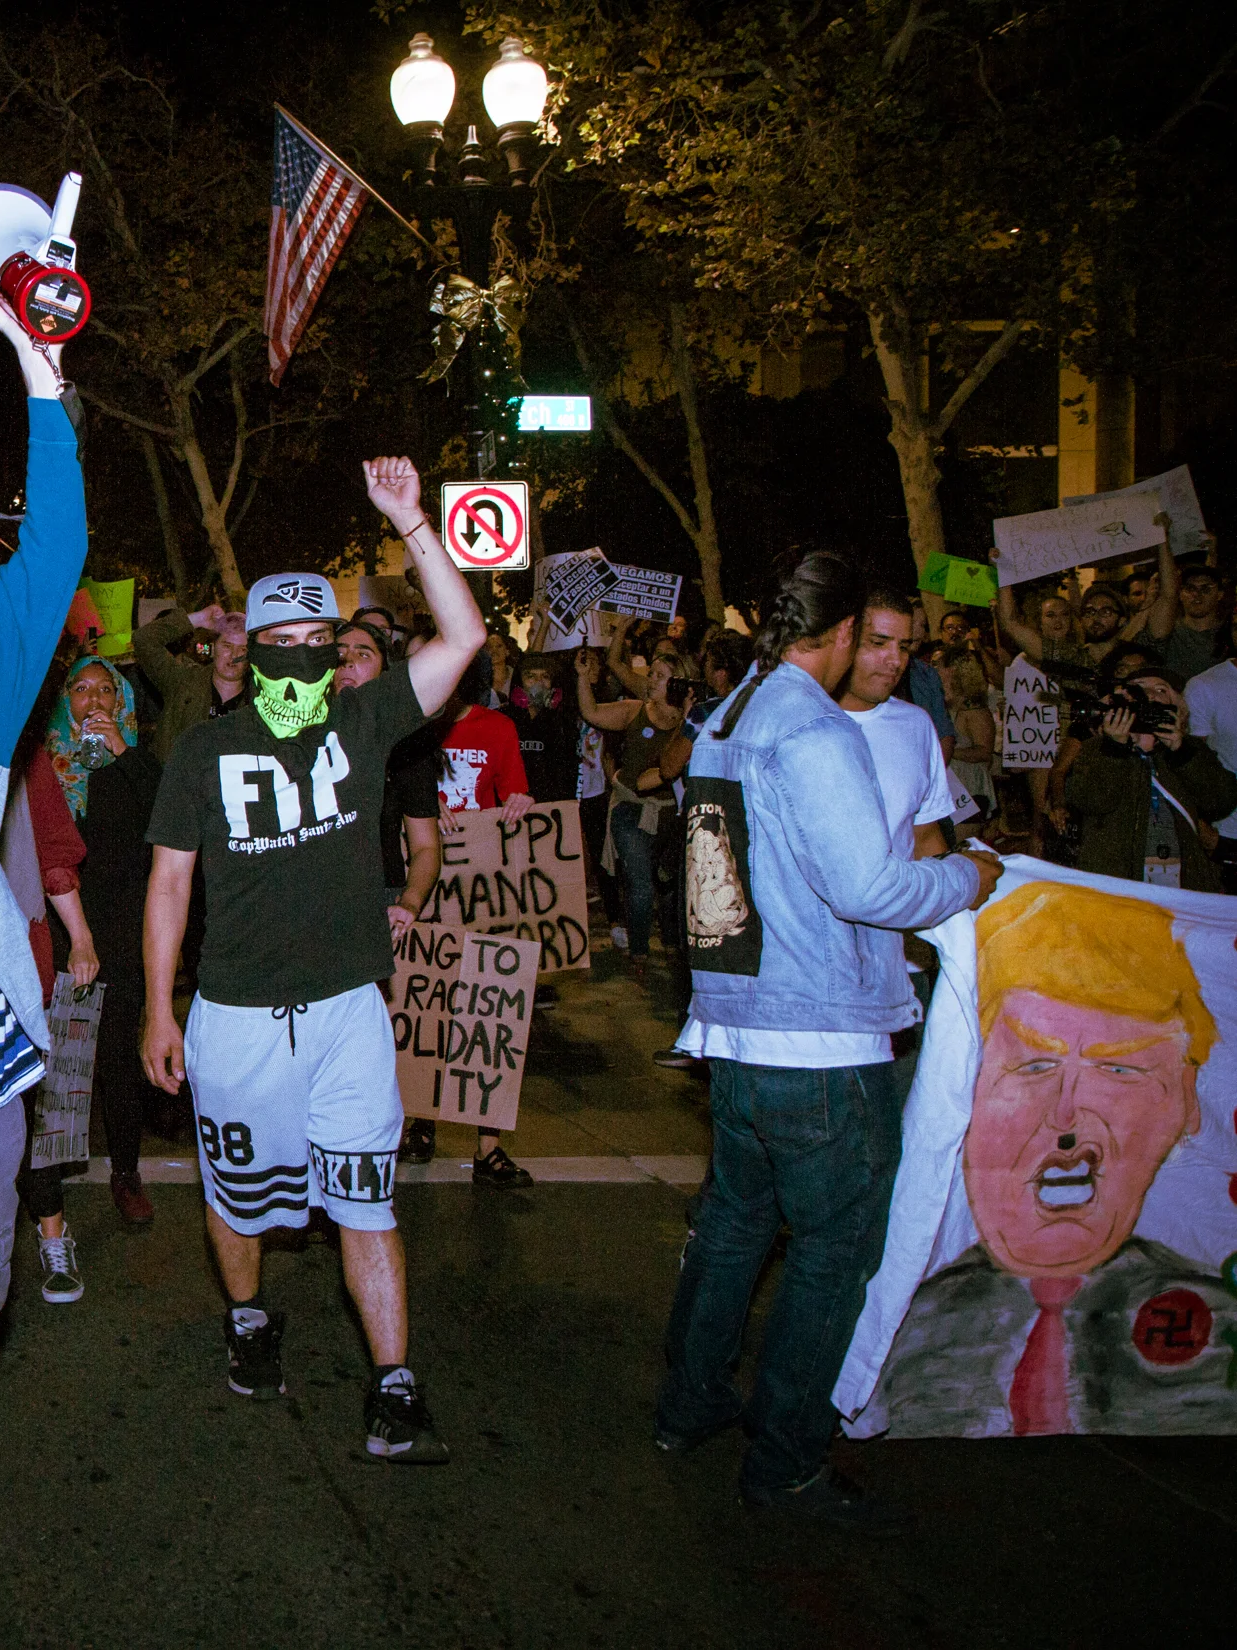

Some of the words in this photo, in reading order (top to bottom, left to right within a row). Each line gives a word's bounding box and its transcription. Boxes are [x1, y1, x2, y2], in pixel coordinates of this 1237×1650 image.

[561, 558, 595, 589] Accept
[564, 568, 600, 602] Fascist
[617, 581, 650, 596] ceptar
[569, 582, 606, 619] America
[640, 595, 671, 609] Unidos
[1014, 677, 1058, 693] MAK
[1004, 749, 1055, 763] #DUM
[496, 808, 581, 866] PPL
[417, 867, 558, 925] MAND
[471, 938, 521, 976] TO
[698, 936, 723, 949] COPS
[404, 973, 526, 1021] RACISM
[391, 1011, 525, 1071] OLIDAR-
[433, 1067, 503, 1117] ITY
